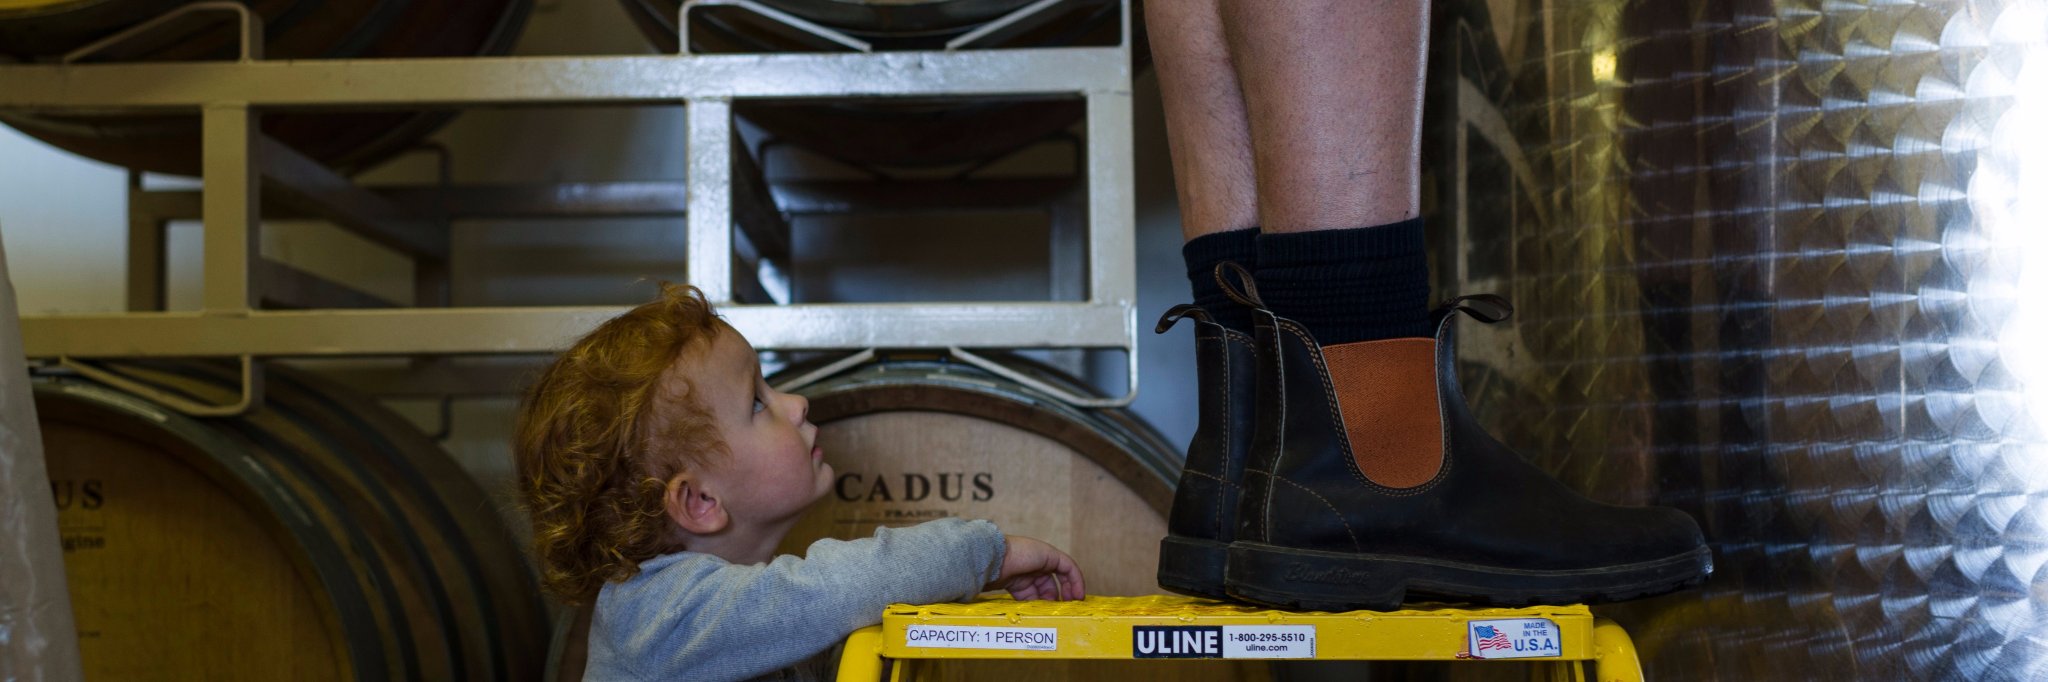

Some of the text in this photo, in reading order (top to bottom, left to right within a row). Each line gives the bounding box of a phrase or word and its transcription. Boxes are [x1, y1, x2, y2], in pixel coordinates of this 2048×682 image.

[835, 472, 994, 502] CADUS
[909, 629, 1054, 644] CAPACITY: 1 PERSON
[1137, 631, 1218, 654] ULINE
[1228, 633, 1305, 642] 1-800-295-5510
[1245, 643, 1288, 652] uline.com
[1514, 638, 1558, 652] U.S.A.
